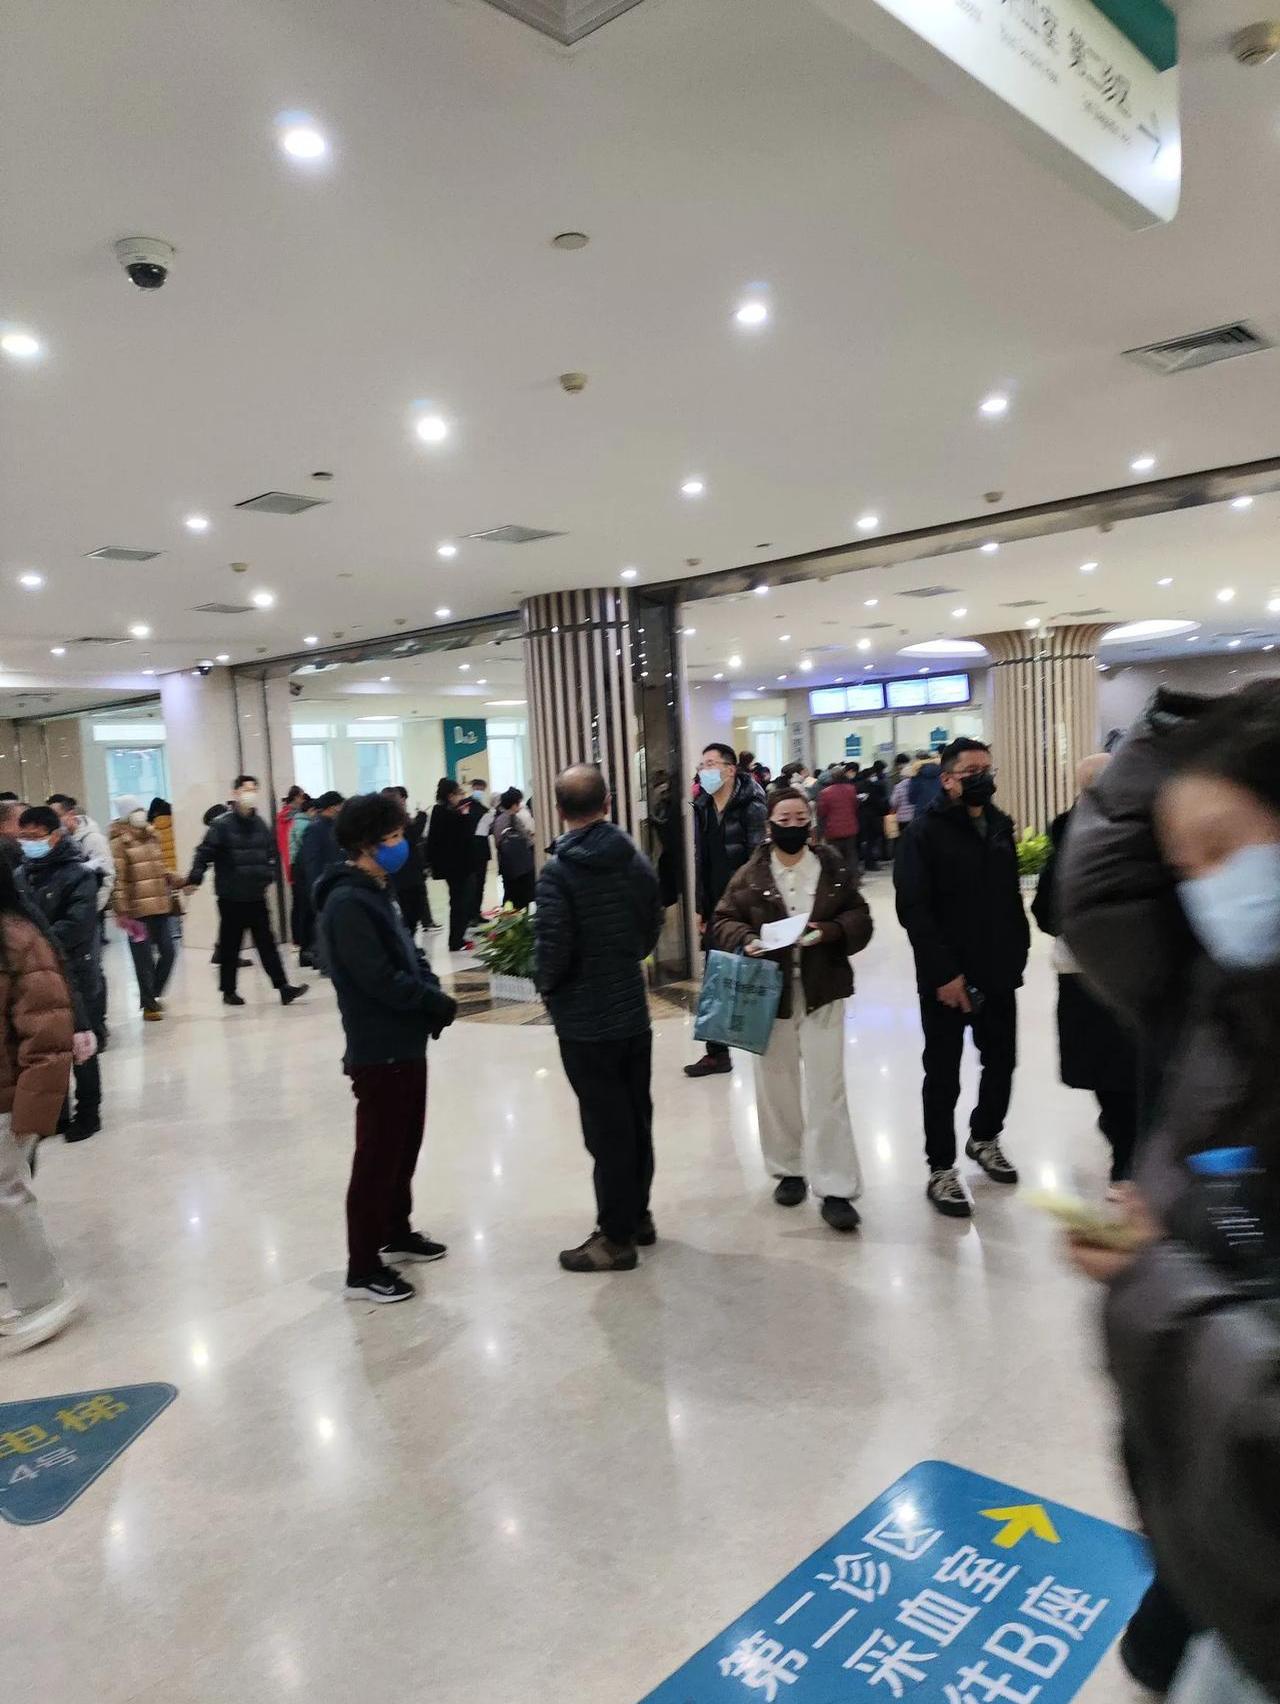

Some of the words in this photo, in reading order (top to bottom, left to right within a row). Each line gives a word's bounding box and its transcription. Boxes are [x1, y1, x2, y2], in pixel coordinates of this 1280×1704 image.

[717, 1506, 945, 1702] 第二诊区
[842, 1545, 1022, 1698] 采血室
